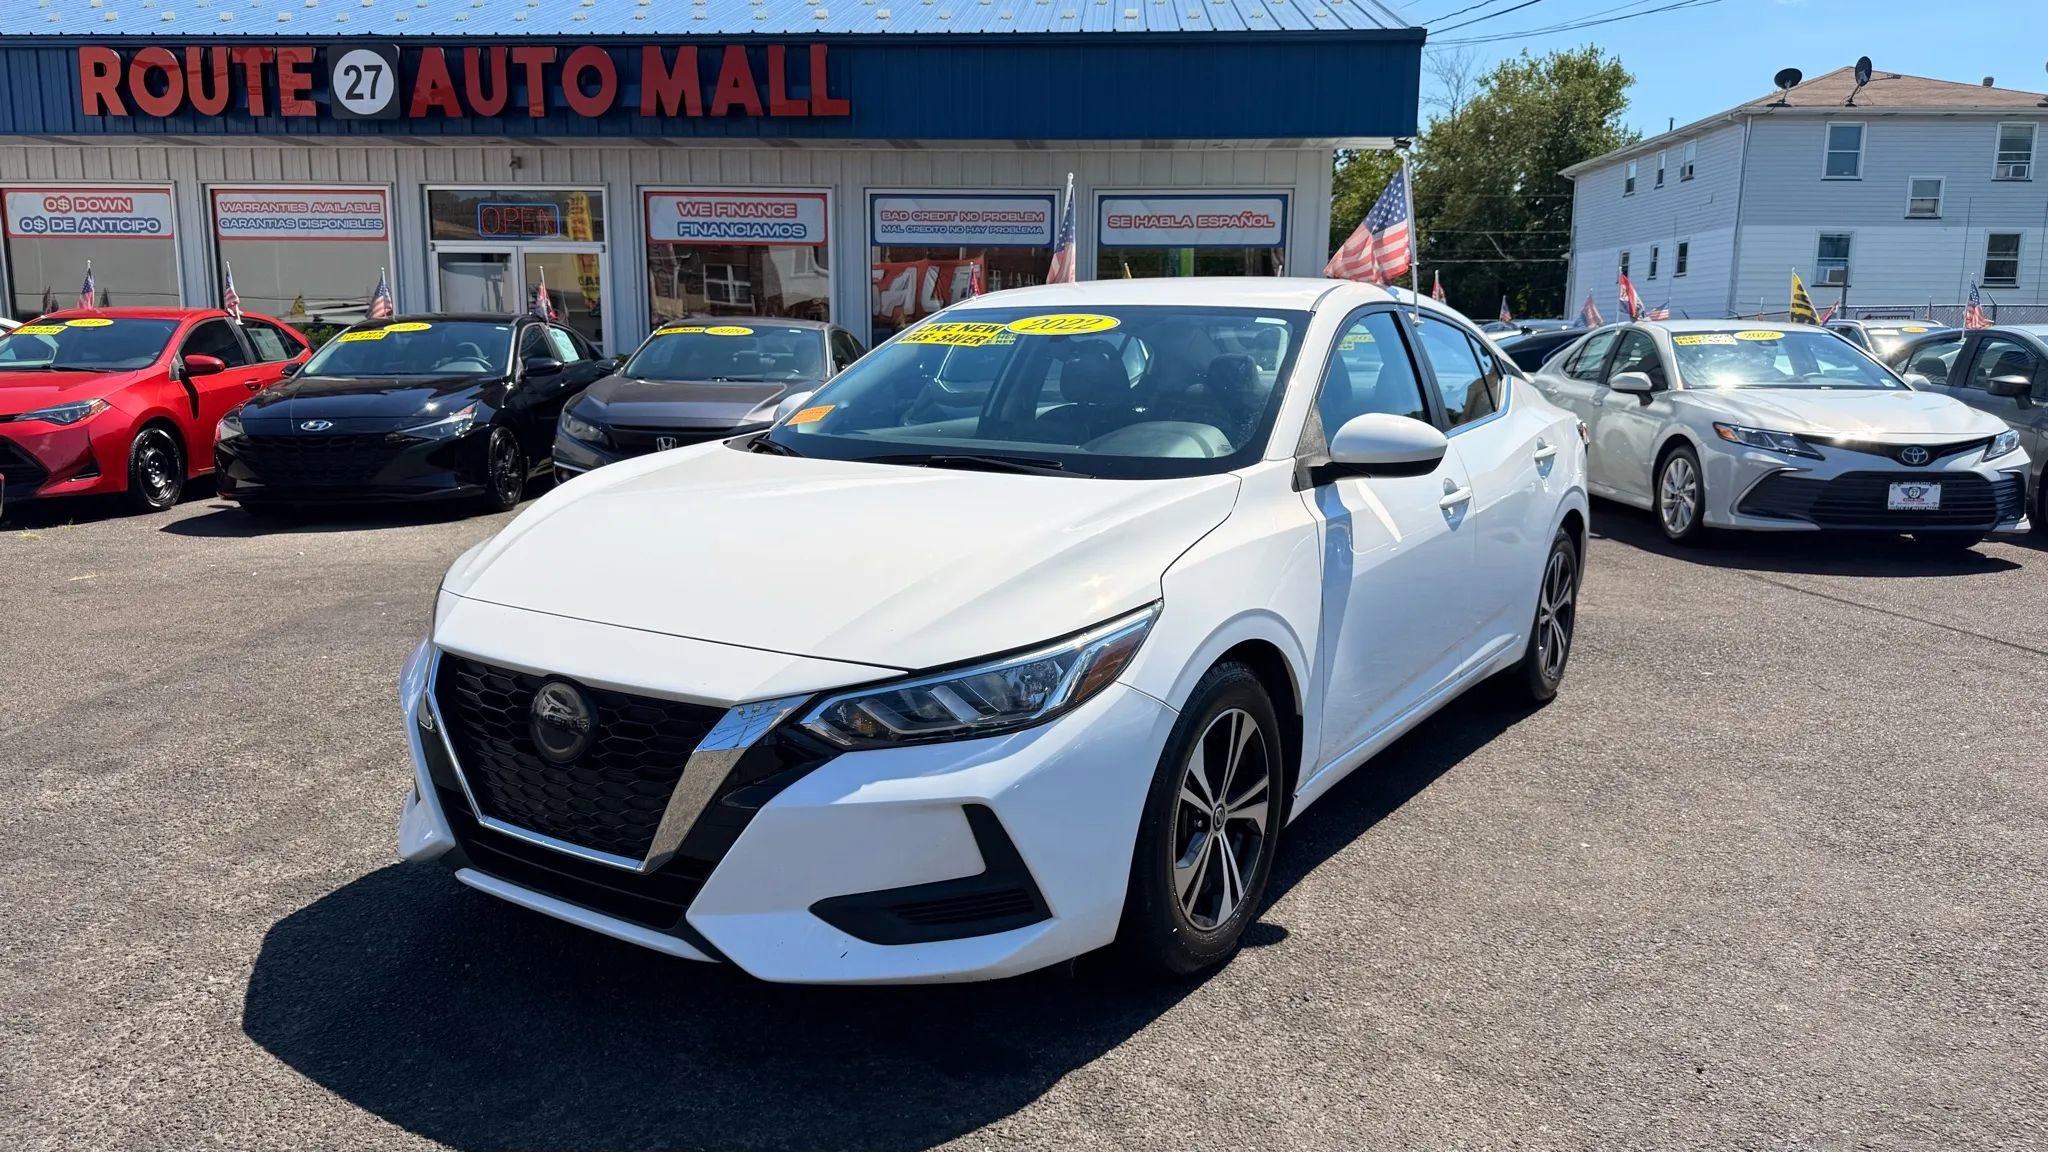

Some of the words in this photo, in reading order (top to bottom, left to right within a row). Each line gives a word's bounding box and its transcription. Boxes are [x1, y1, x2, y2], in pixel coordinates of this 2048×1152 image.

[79, 46, 317, 117] ROUTE
[343, 64, 383, 101] 27
[408, 46, 617, 118] AUTO
[640, 44, 850, 117] MALL
[74, 197, 134, 213] DOWN
[220, 201, 308, 213] WARRANTIES
[311, 202, 382, 214] AVAILABLE
[677, 202, 712, 217] WE
[714, 202, 797, 218] FINANCE
[219, 217, 296, 230] GARANTIAS
[298, 218, 384, 230] DISPONIBLES
[481, 206, 556, 235] OPEN
[881, 210, 910, 222] BAD
[911, 211, 957, 222] CREDIT
[960, 211, 980, 222] NO
[982, 211, 1045, 223] PROBLEM
[1107, 215, 1133, 229] SE
[1134, 214, 1194, 228] HABLA
[1196, 211, 1275, 228] ESPAÑOL
[50, 217, 76, 232] DE
[78, 217, 161, 233] ANTICIPO
[678, 221, 807, 238] FINANCIAMOS
[882, 225, 904, 233] MAL
[906, 225, 947, 233] CREDITO
[949, 225, 964, 233] NO
[966, 225, 988, 234] HAY
[989, 225, 1044, 234] PROBLEMA
[916, 323, 958, 332] LIKE
[961, 323, 1004, 333] NEW
[1019, 318, 1104, 331] 2022
